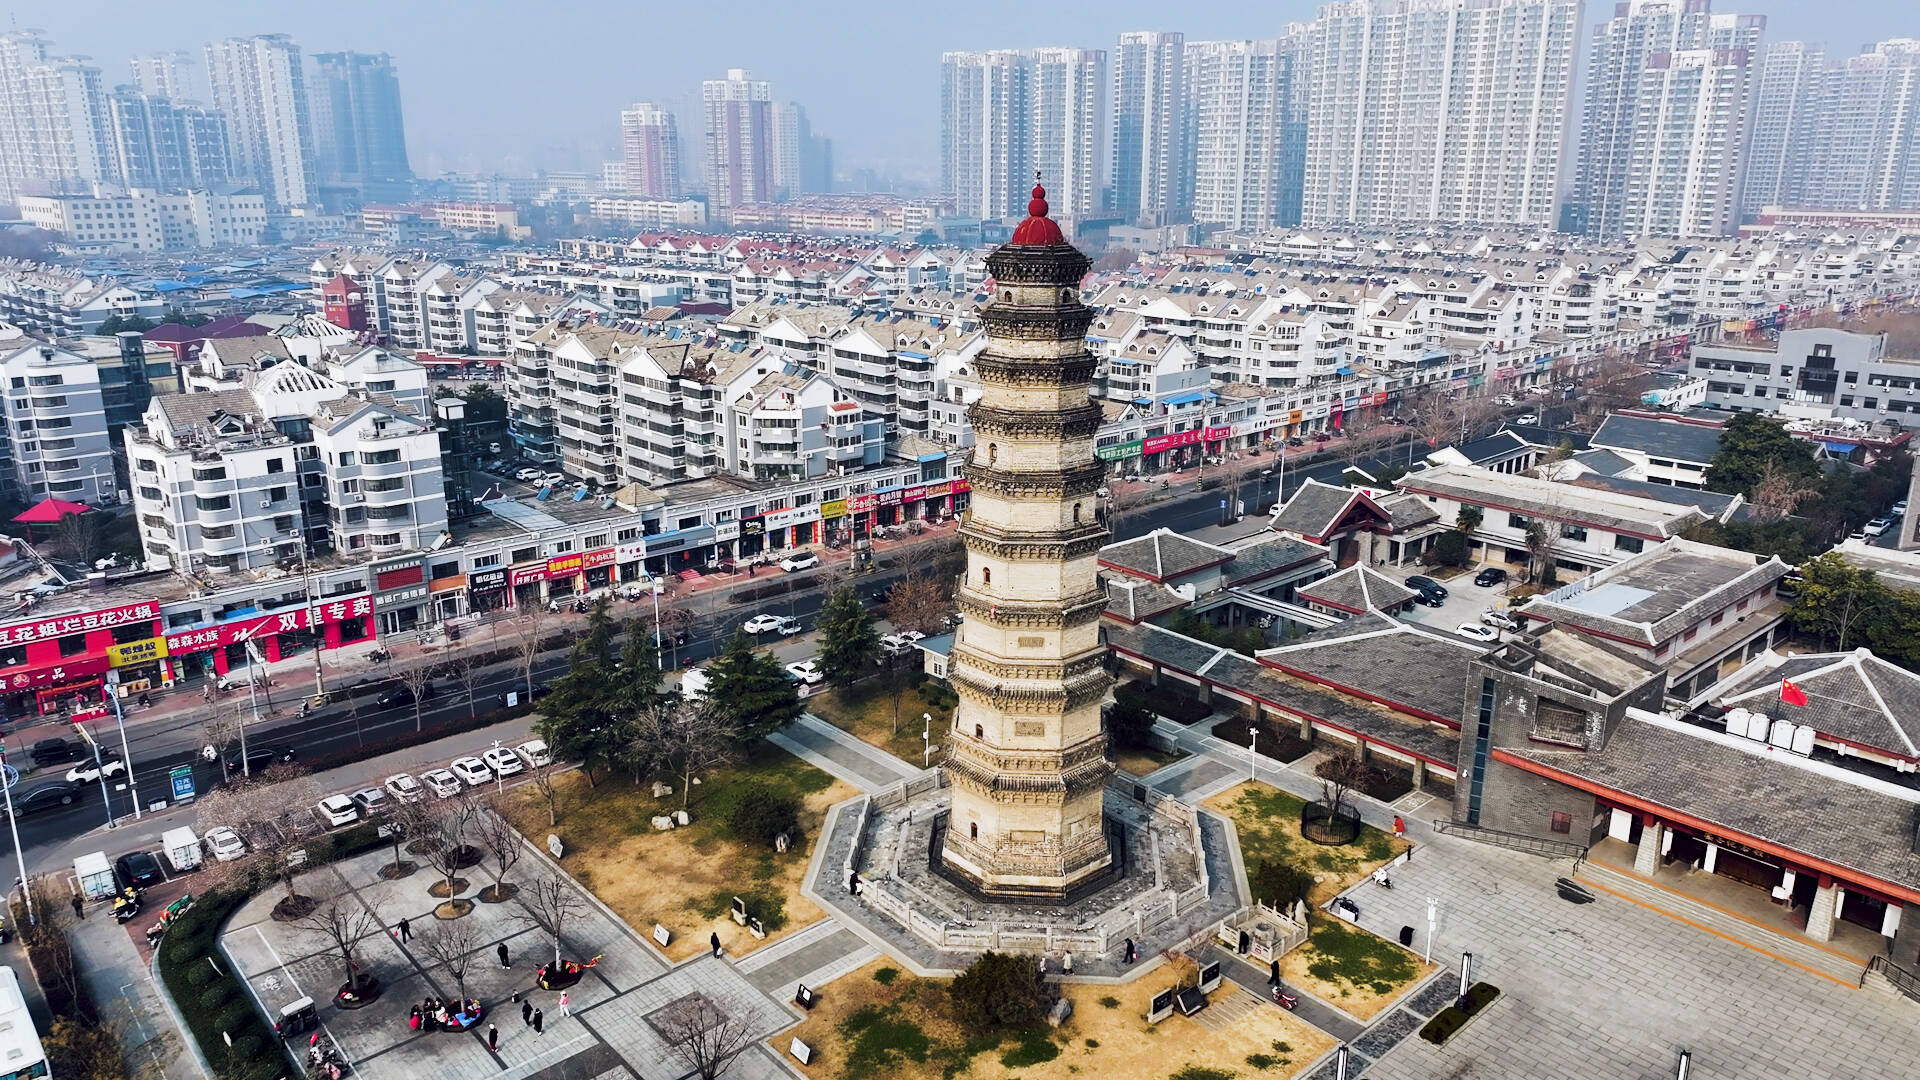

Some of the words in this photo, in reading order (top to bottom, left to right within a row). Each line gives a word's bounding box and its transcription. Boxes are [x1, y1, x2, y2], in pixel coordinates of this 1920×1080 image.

[278, 597, 371, 632] 双星专卖
[168, 629, 220, 650] 森森水族
